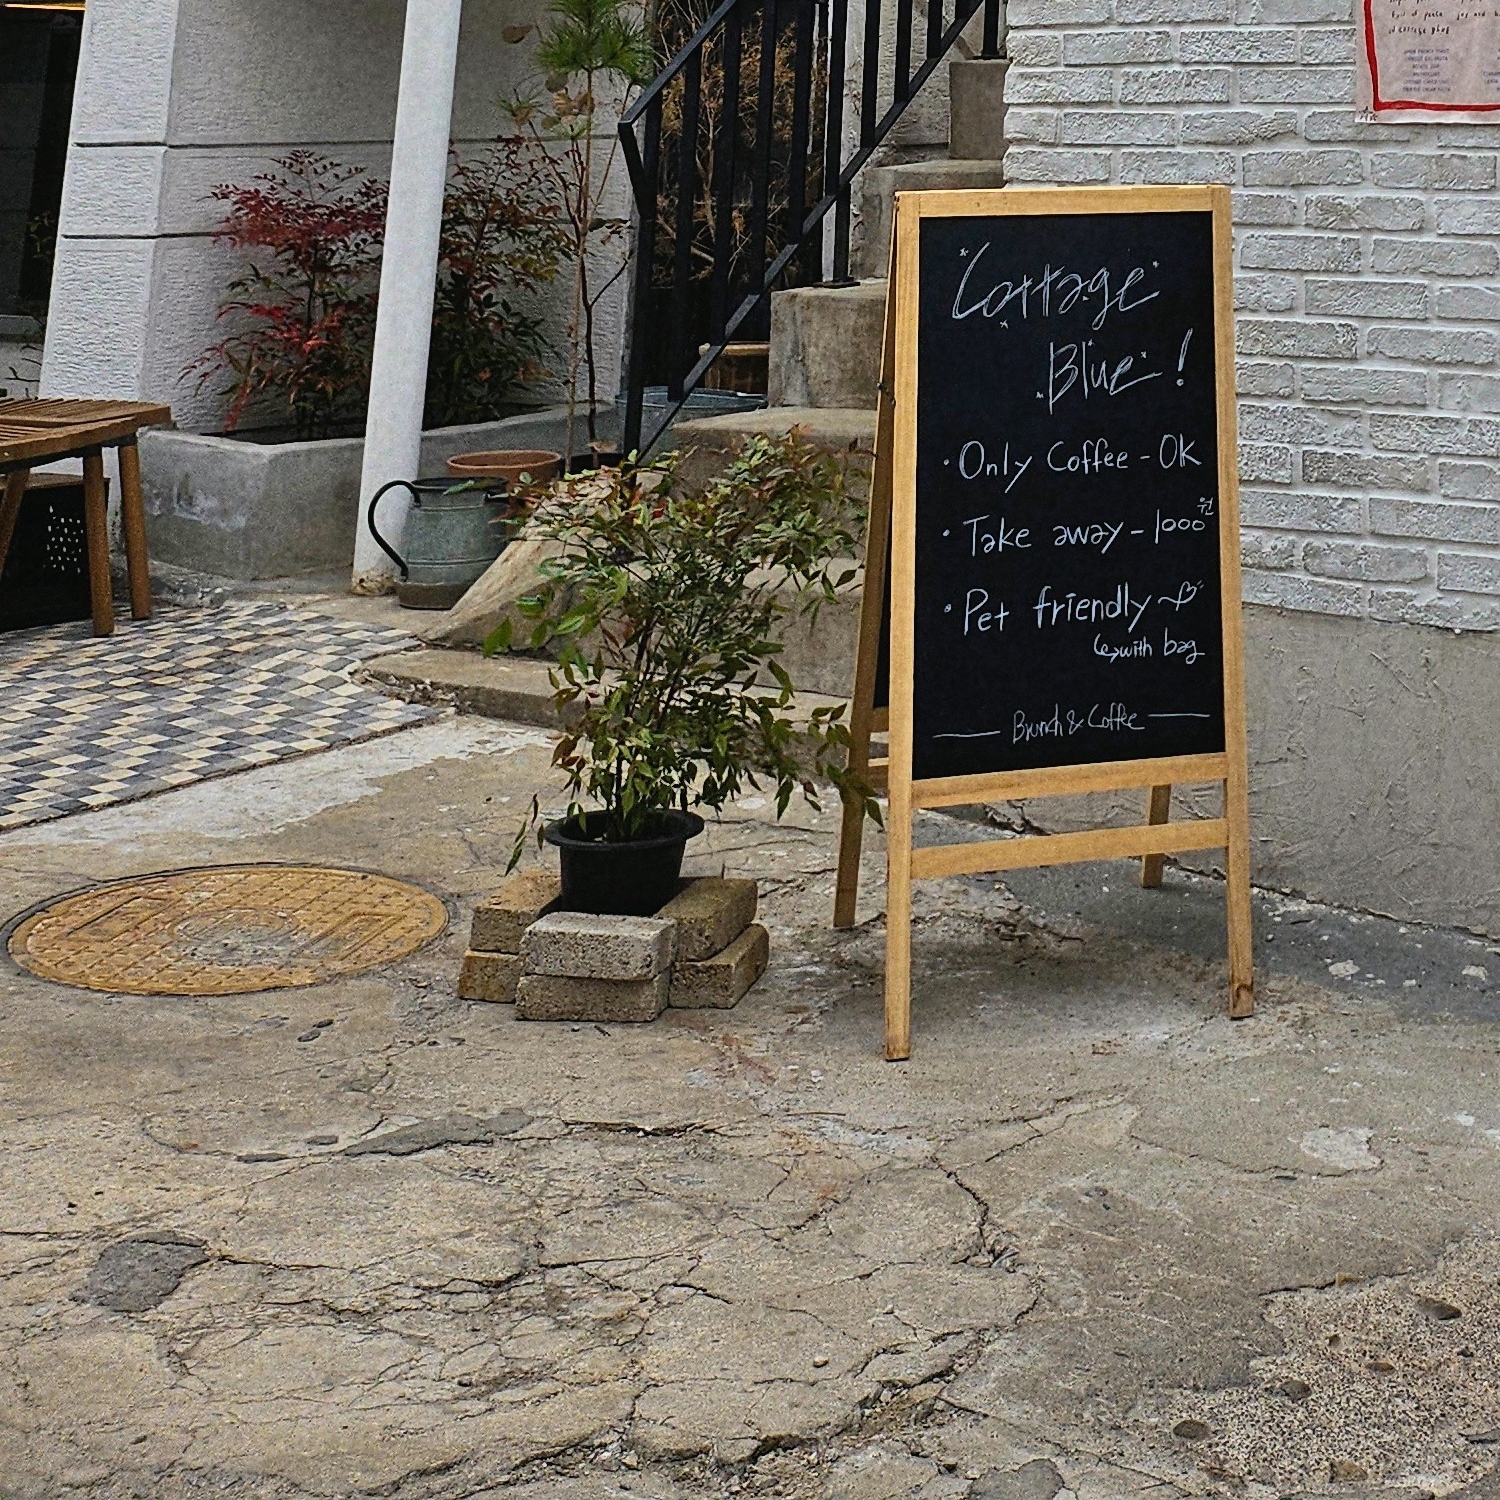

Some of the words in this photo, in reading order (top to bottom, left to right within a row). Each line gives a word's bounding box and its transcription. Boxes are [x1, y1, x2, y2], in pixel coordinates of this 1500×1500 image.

[952, 241, 1161, 331] Cottage
[959, 440, 1033, 494] Only
[1046, 438, 1129, 475] Coffee
[1159, 434, 1202, 469] OK
[963, 514, 1032, 557] Take
[1053, 522, 1125, 555] away
[964, 588, 1010, 636] Pet
[1033, 582, 1152, 633] friendly
[1119, 636, 1152, 658] with
[1163, 627, 1206, 664] bag
[1013, 704, 1063, 744] Brunch
[1068, 710, 1084, 735] &
[1088, 702, 1145, 731] Coffee
